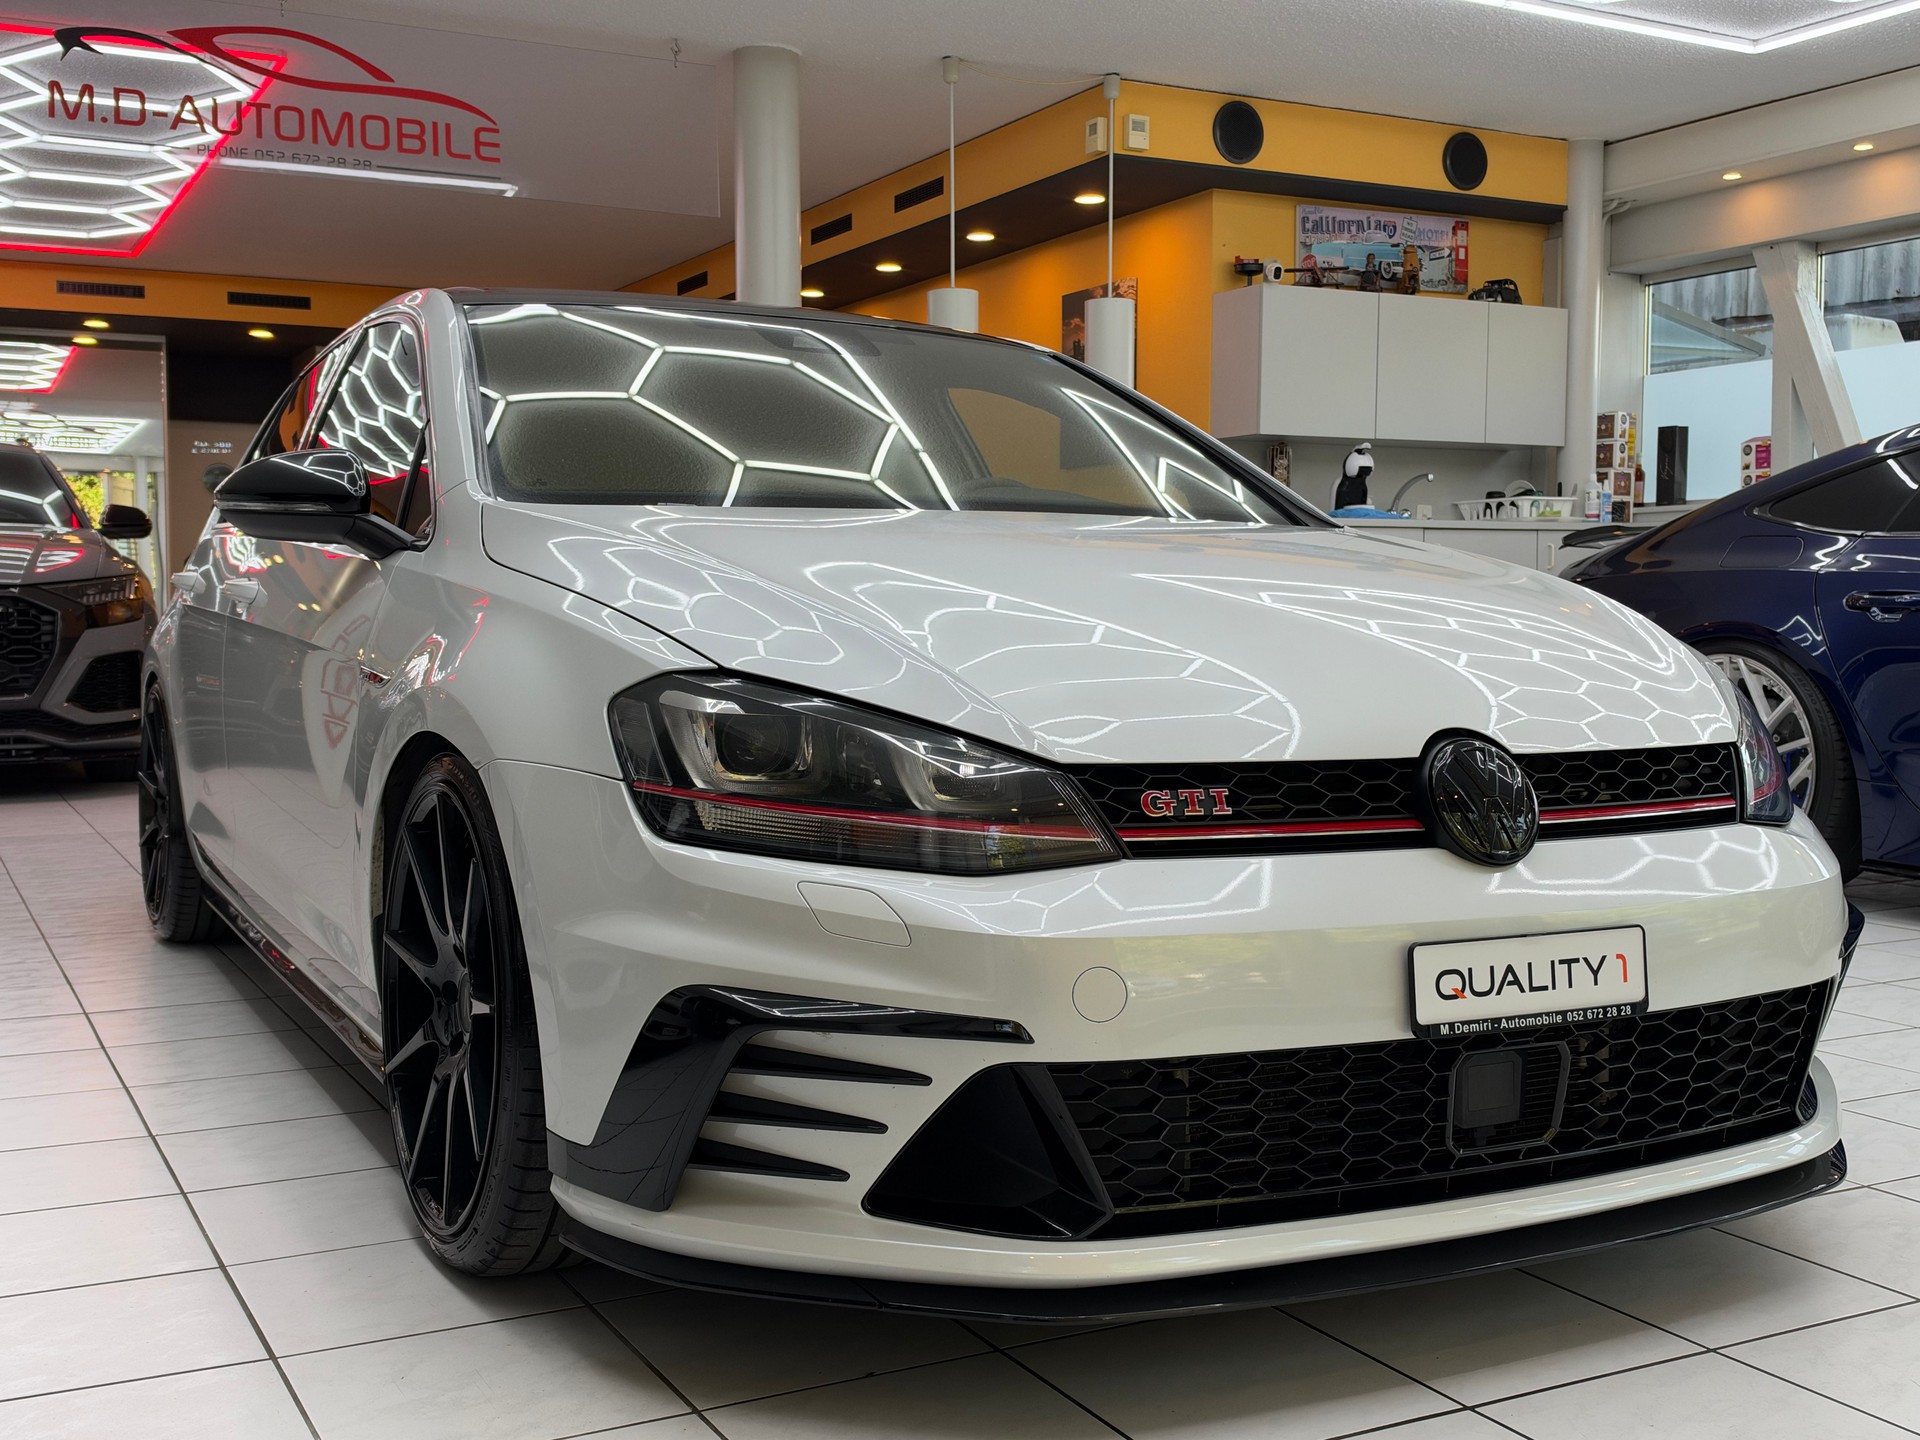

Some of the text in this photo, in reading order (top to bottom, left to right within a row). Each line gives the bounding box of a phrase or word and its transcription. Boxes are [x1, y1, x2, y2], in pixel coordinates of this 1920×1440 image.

[47, 80, 501, 163] M.D-AUTOMOBILE
[1301, 216, 1382, 235] California
[1385, 226, 1395, 236] 10
[1140, 788, 1234, 818] GTI
[1435, 953, 1628, 1001] QUALITY 1
[1500, 1013, 1563, 1030] Automobile
[1566, 1010, 1584, 1022] 052
[1587, 1007, 1604, 1020] 672
[1606, 1006, 1618, 1018] 28
[1620, 1004, 1632, 1016] 28
